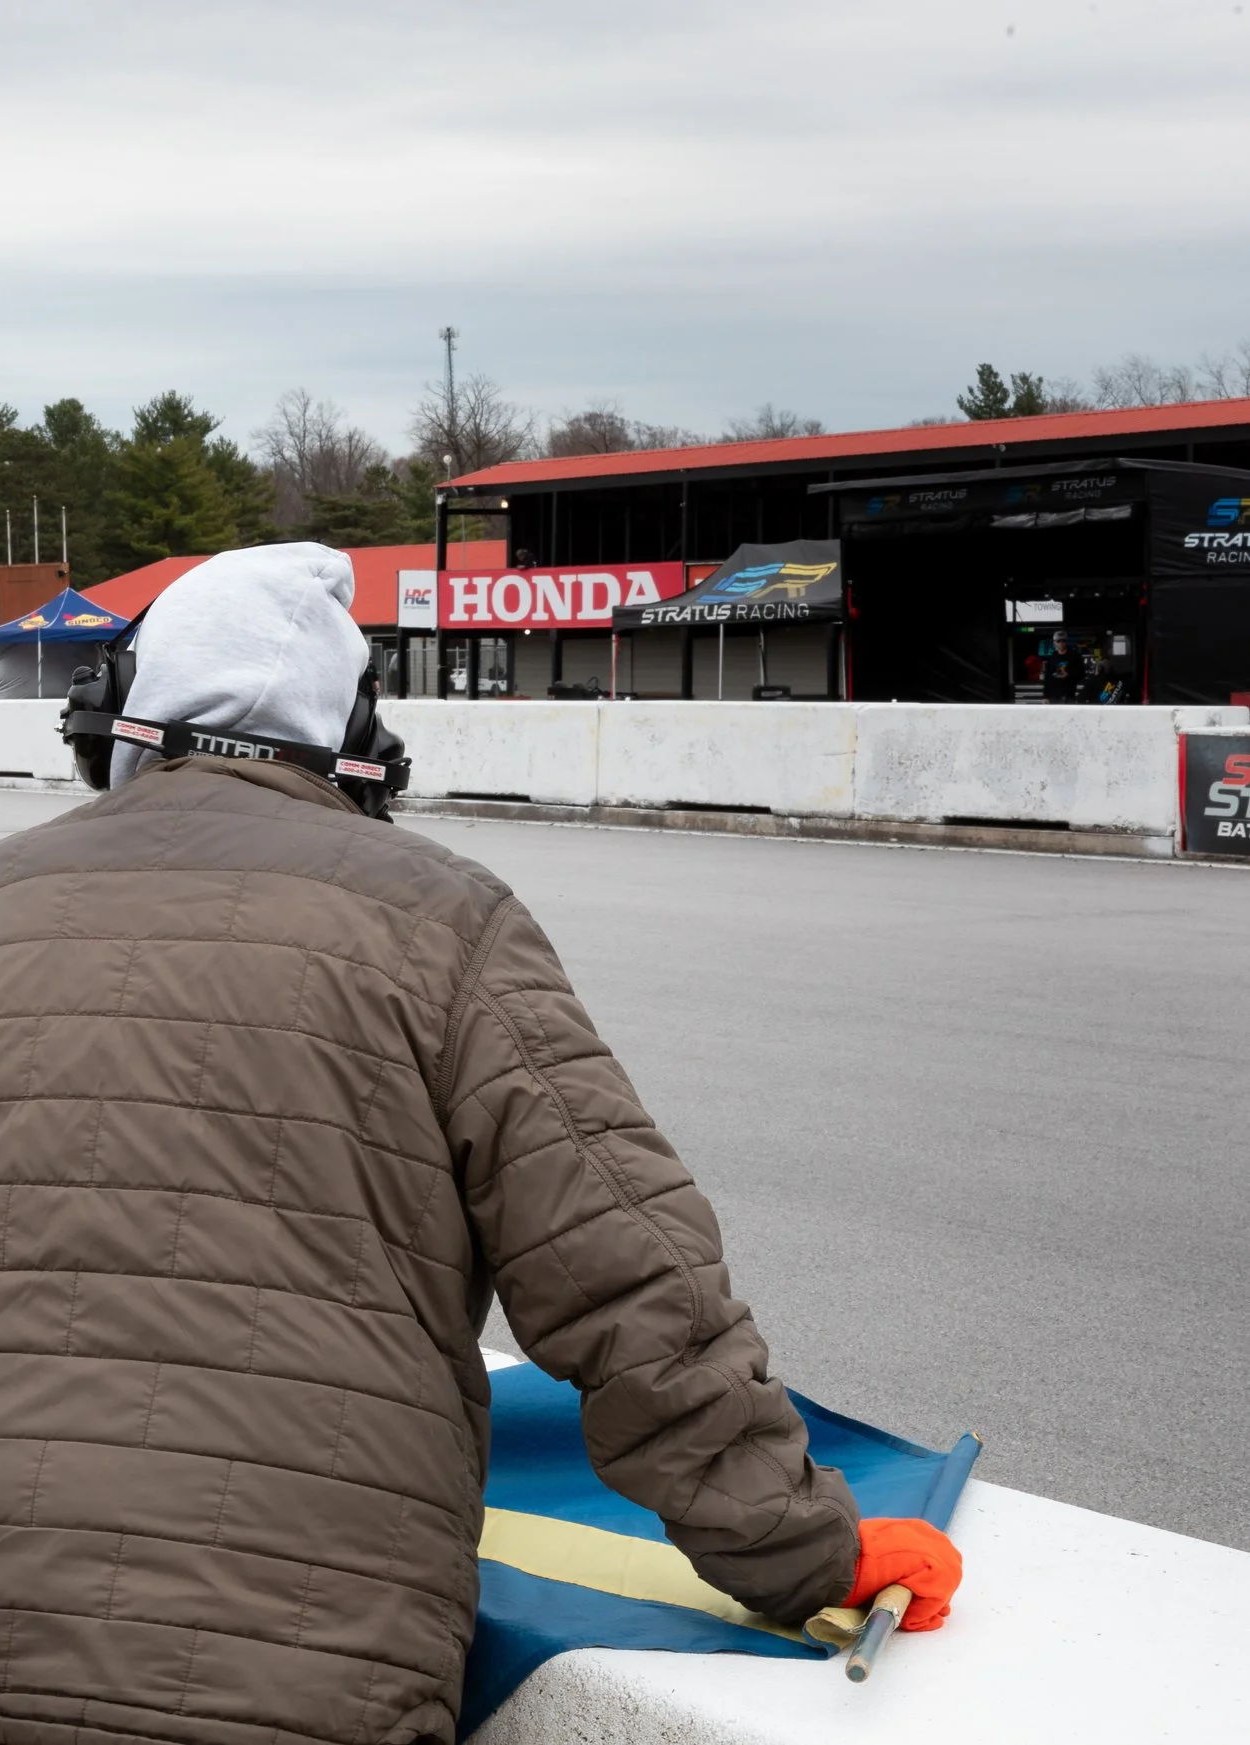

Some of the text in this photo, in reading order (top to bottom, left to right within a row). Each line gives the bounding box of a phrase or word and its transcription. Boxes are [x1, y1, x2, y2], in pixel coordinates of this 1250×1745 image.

[1051, 476, 1118, 491] STRATUS
[908, 488, 969, 503] STRATUS
[404, 589, 432, 605] HRC
[449, 571, 663, 623] HONDA
[67, 617, 110, 626] SUNOCO
[641, 603, 810, 625] STRATUS RACING
[191, 732, 275, 760] TITAN
[1217, 821, 1250, 838] BA
